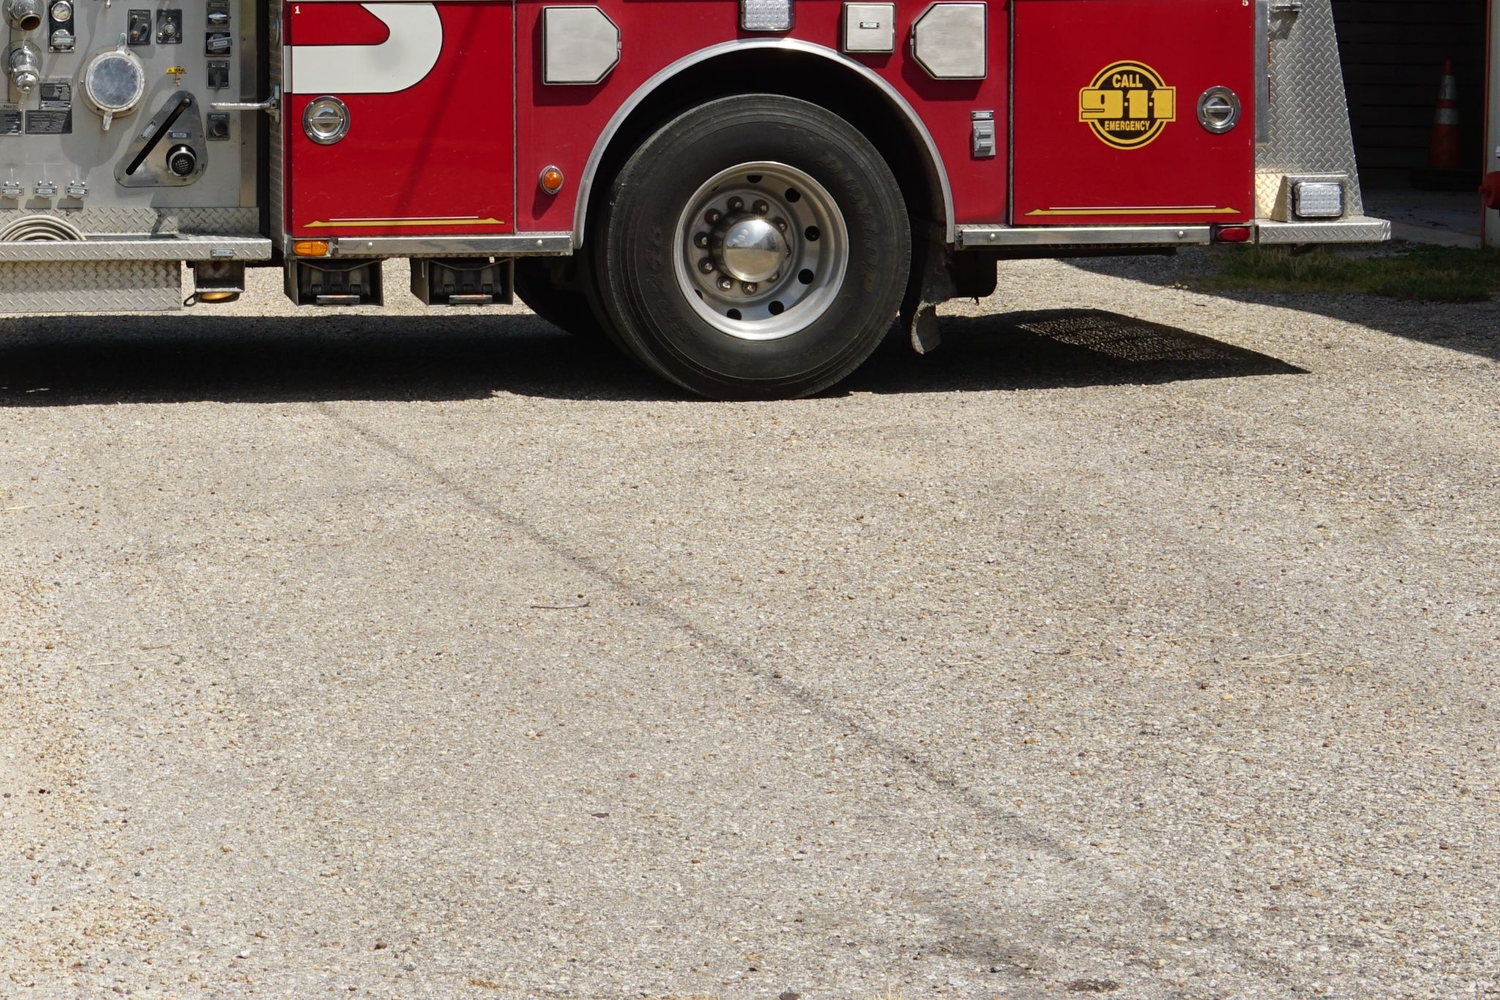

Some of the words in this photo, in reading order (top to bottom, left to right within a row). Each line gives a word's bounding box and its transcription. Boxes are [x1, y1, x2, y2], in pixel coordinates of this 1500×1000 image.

[294, 5, 301, 14] 1
[1112, 74, 1143, 88] CALL
[1104, 120, 1150, 131] EMERGENCY
